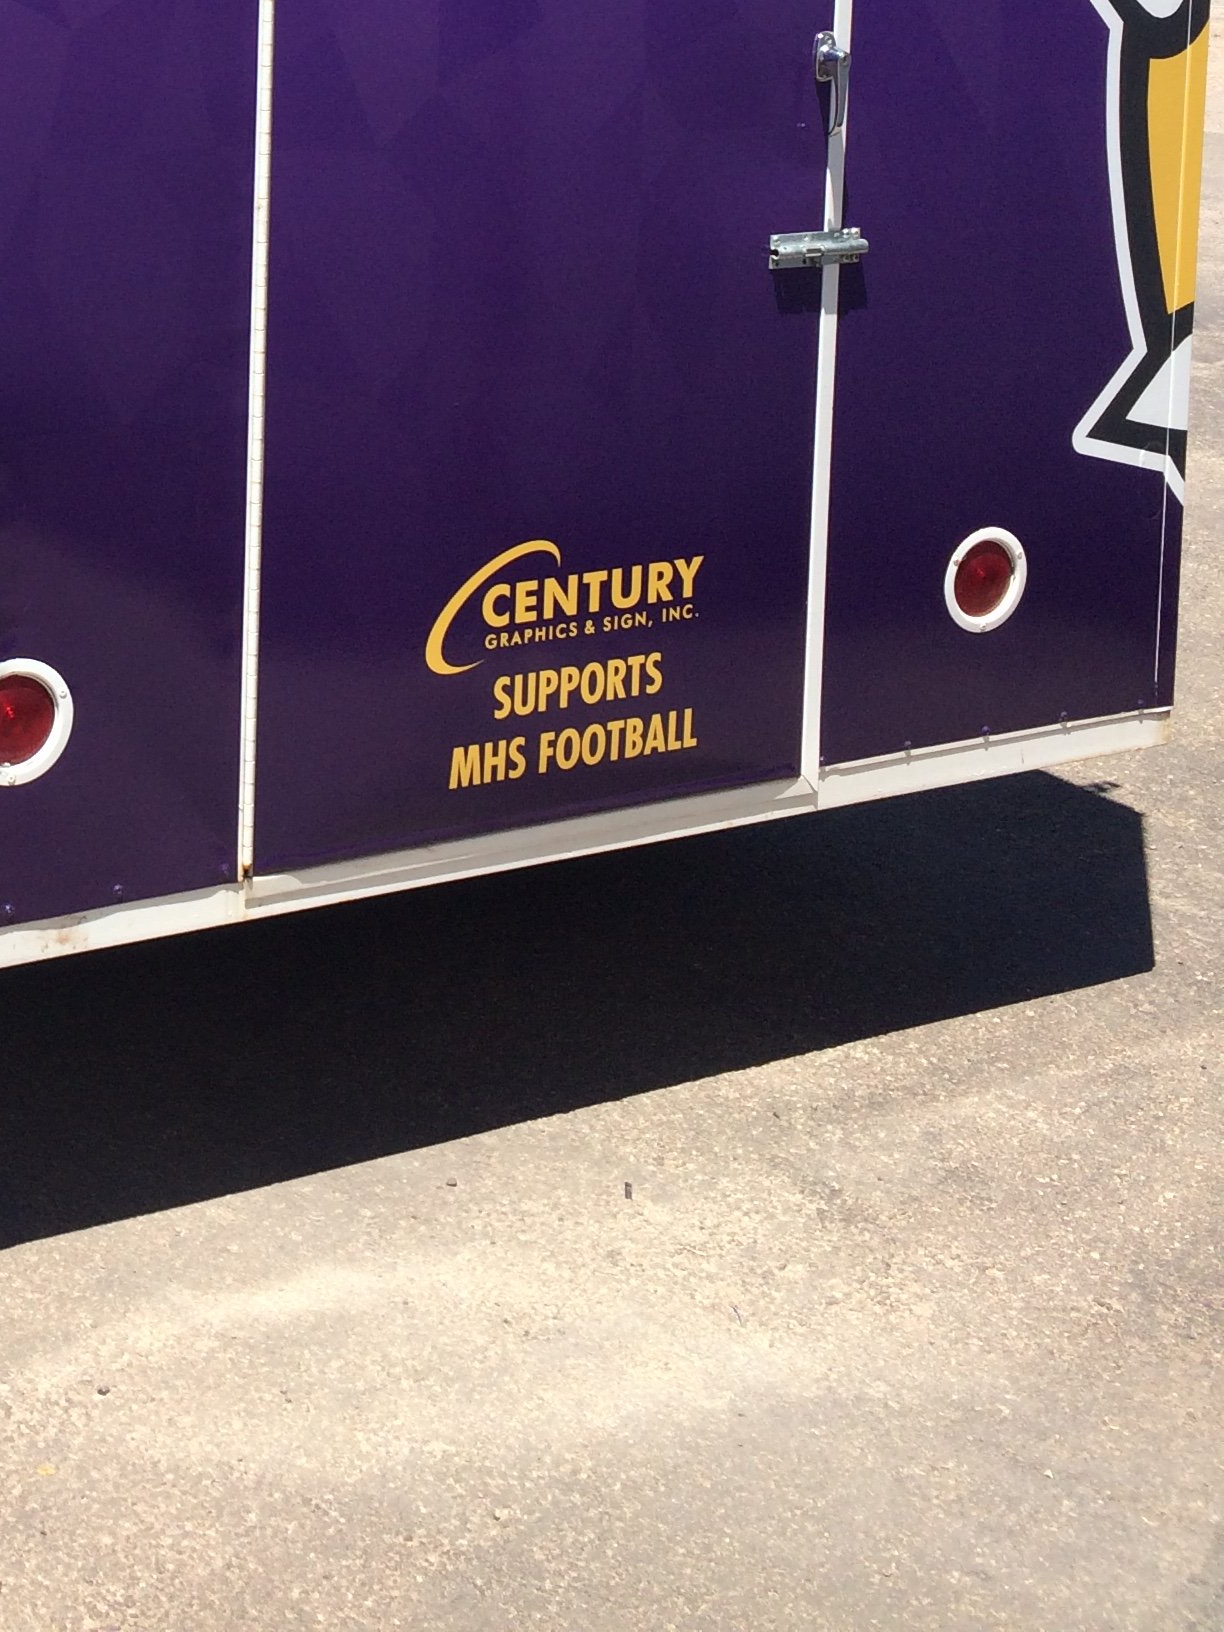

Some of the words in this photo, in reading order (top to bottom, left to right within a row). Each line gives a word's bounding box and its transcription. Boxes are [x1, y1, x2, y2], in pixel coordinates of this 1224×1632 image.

[482, 555, 705, 628] CENTURY
[484, 622, 578, 650] GRAPHICS
[584, 619, 596, 635] &
[602, 611, 653, 632] SIGN,
[662, 604, 700, 623] INC.
[493, 652, 663, 720] SUPPORTS
[448, 736, 527, 790] MHS
[538, 708, 697, 774] FOOTBALL
